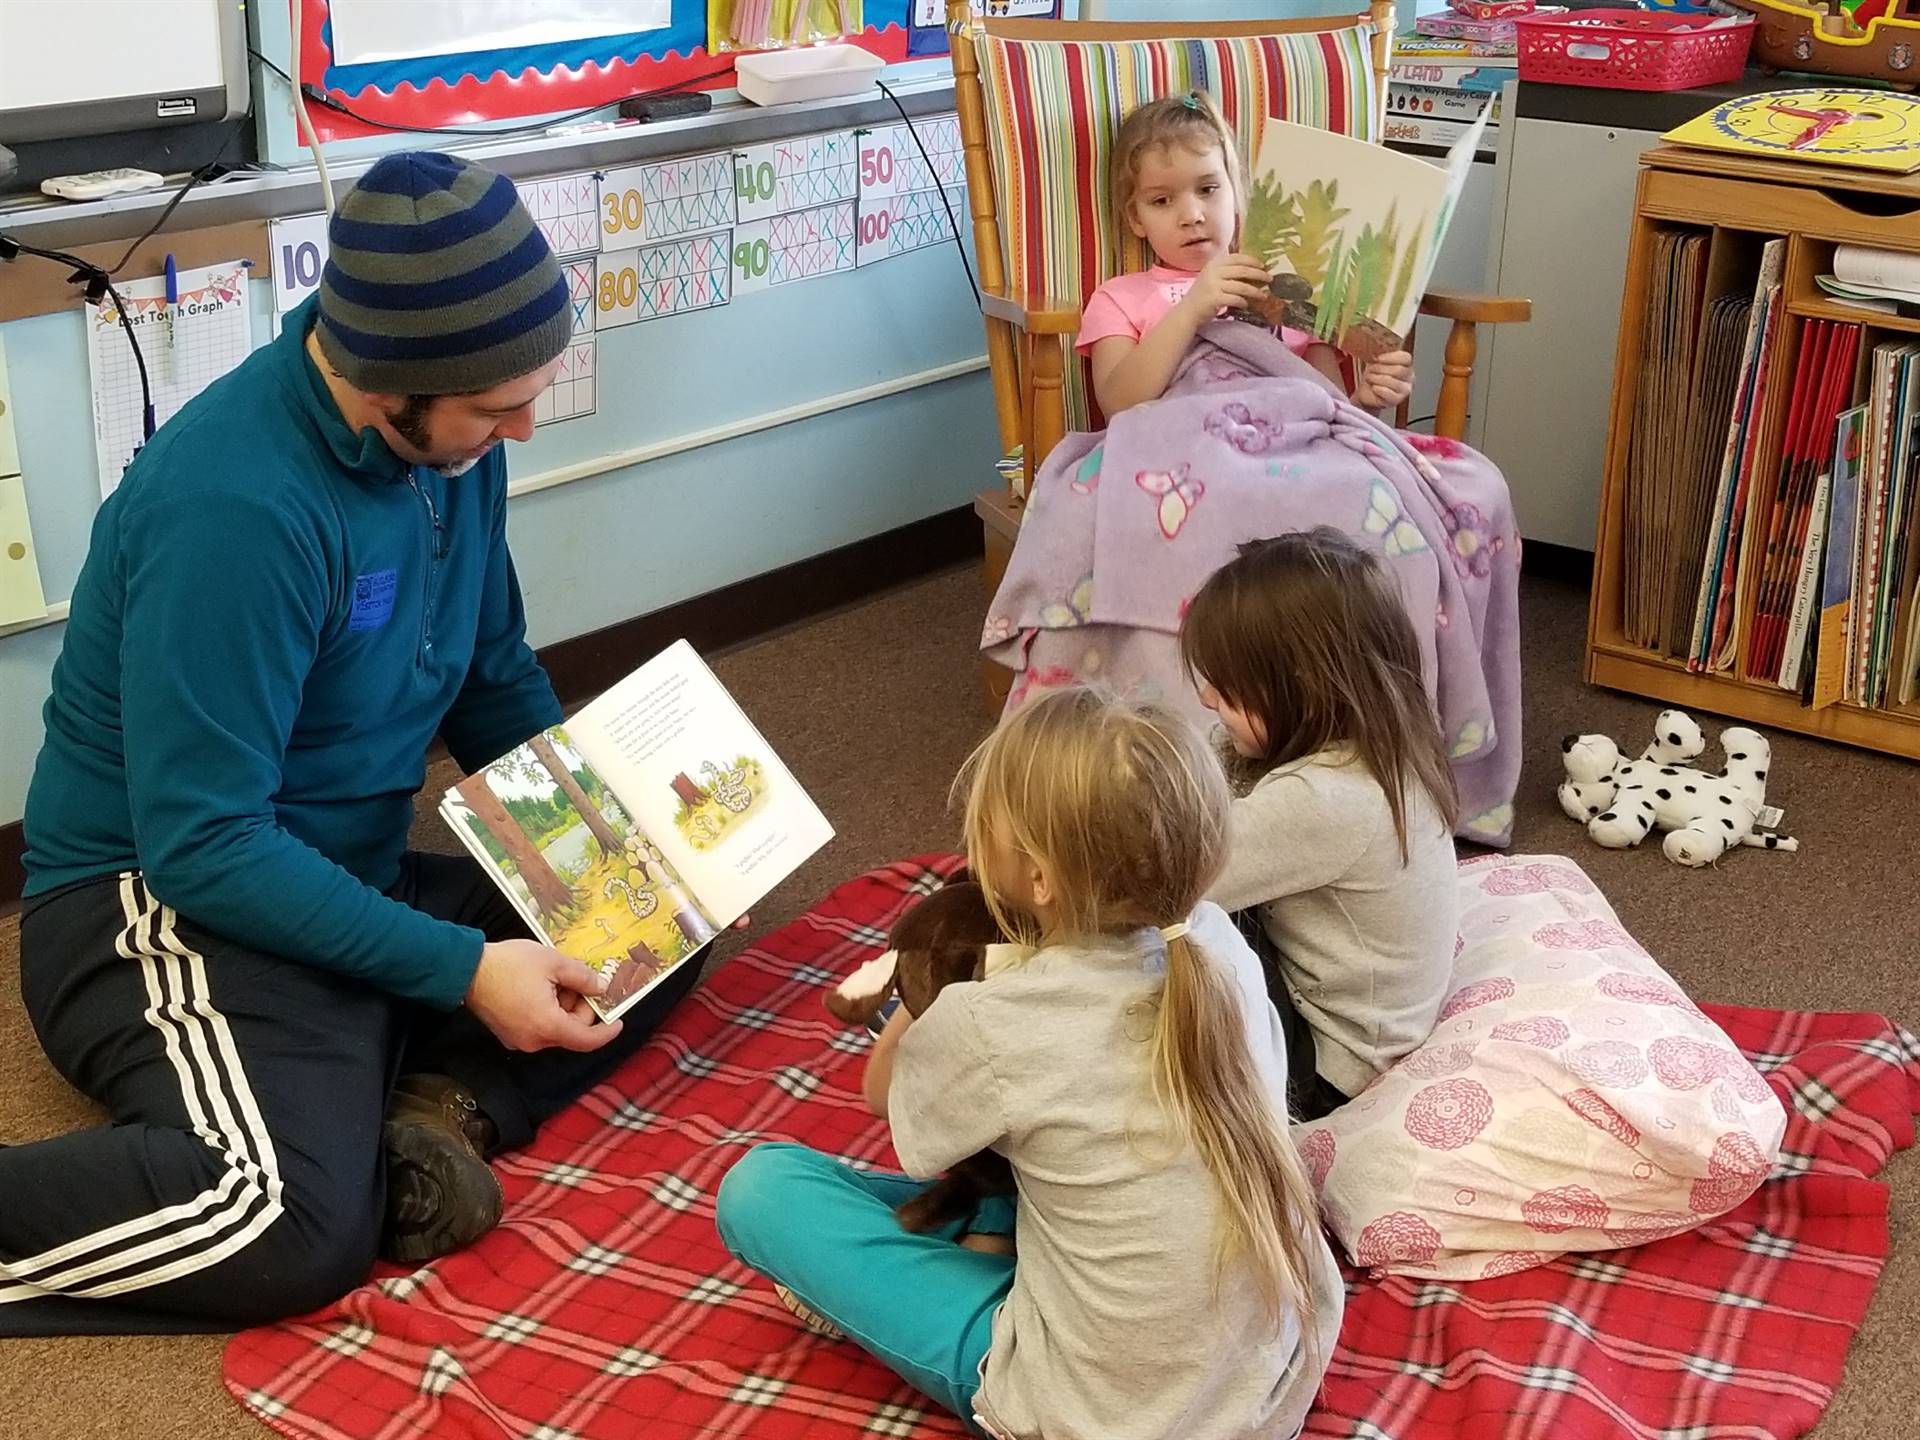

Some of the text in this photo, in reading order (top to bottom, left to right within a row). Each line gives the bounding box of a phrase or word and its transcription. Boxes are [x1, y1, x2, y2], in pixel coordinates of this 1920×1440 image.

[1399, 42, 1468, 51] TROUBLE
[1403, 65, 1443, 82] LAND
[1409, 85, 1421, 93] The
[1424, 87, 1439, 96] Very
[1441, 89, 1468, 99] Hungry
[1817, 94, 1840, 102] 11
[1857, 95, 1887, 104] 12
[1444, 99, 1466, 107] Game
[862, 146, 893, 186] 50
[736, 161, 777, 203] 40
[602, 188, 643, 234] 30
[858, 210, 889, 246] 100
[282, 241, 321, 290] 10
[733, 238, 769, 280] 90
[598, 266, 637, 311] 80
[188, 299, 223, 315] Graph
[1812, 533, 1821, 546] The
[1805, 549, 1818, 564] Very
[1800, 566, 1815, 594] Hungry
